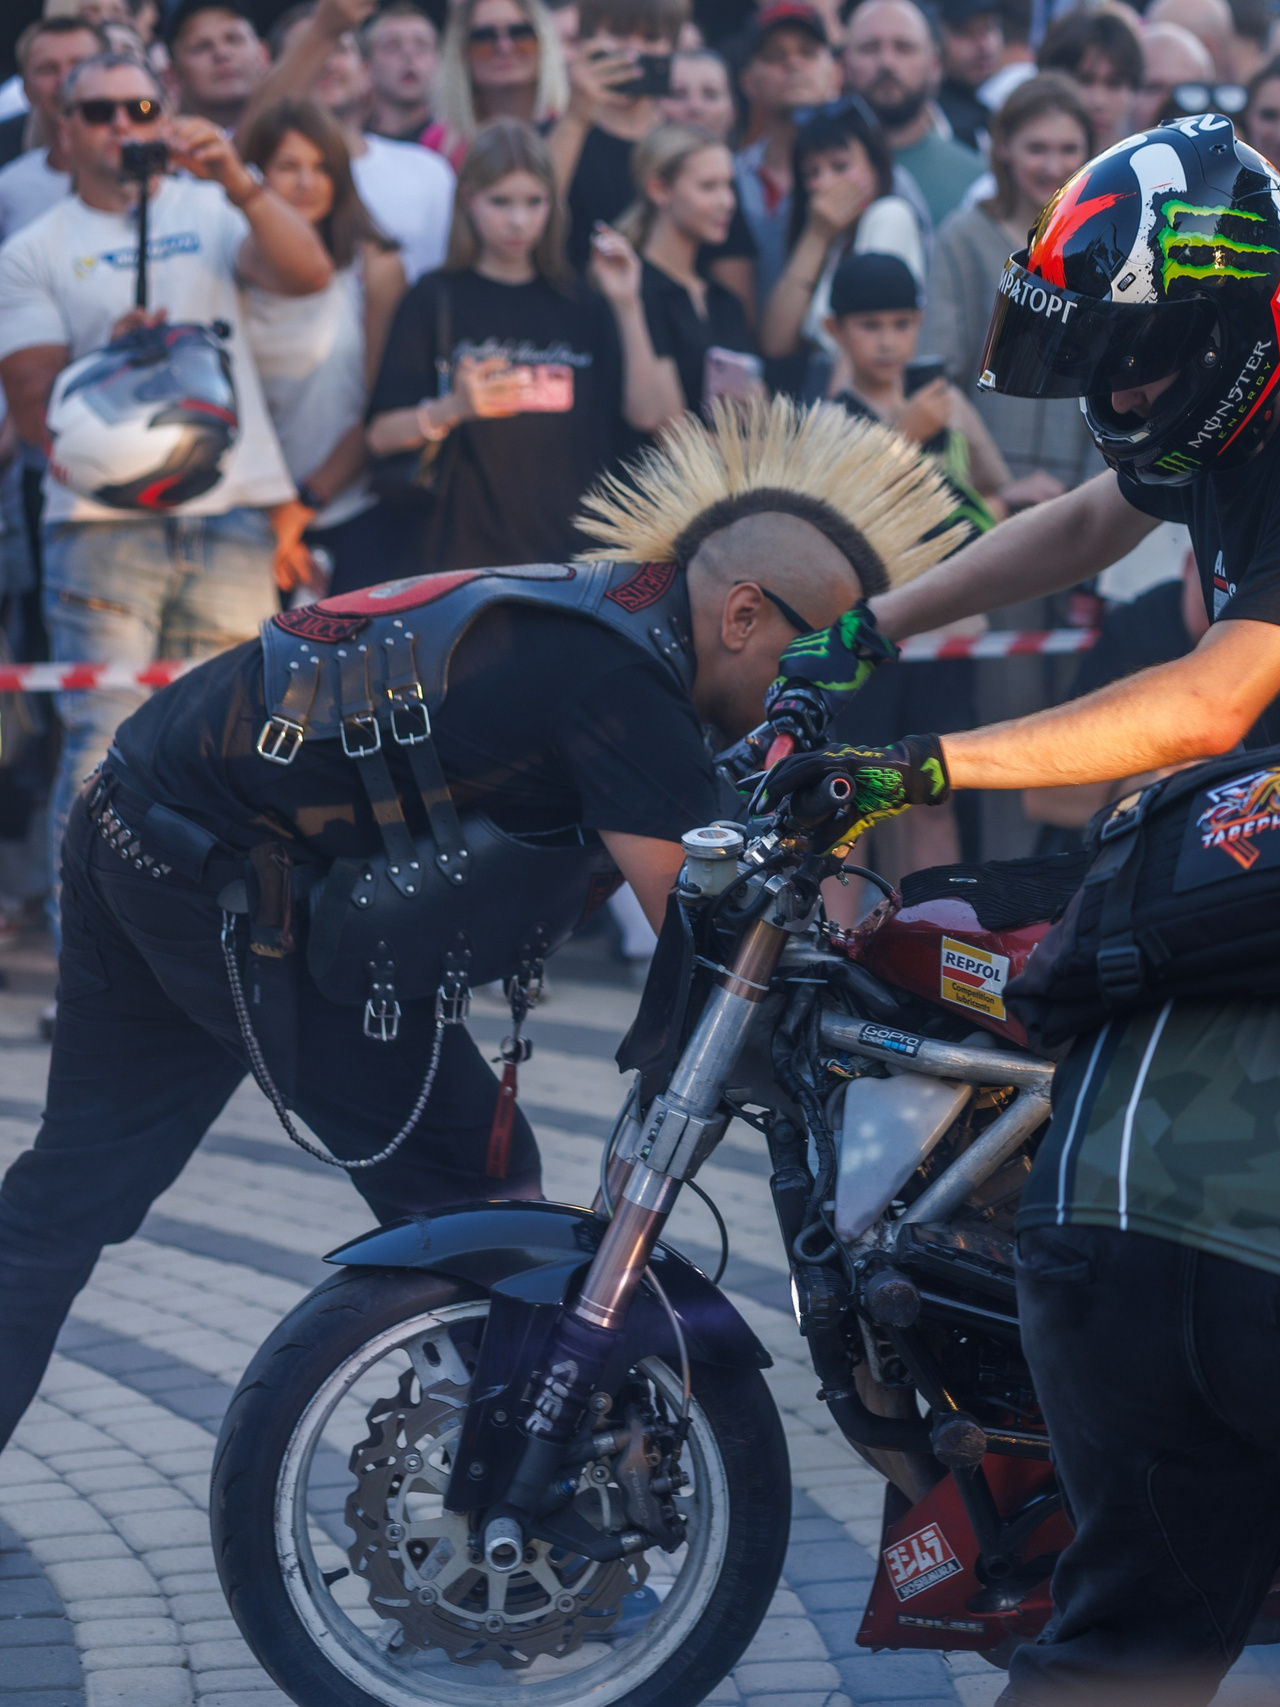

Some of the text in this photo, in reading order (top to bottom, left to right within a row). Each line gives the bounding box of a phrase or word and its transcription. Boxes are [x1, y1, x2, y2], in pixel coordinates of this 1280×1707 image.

[1188, 340, 1272, 448] MONSTER
[1218, 362, 1271, 439] ENERGY
[945, 951, 1002, 982] REPSOL
[951, 982, 995, 1004] Competition
[955, 992, 991, 1012] lubricants
[865, 1025, 919, 1046] GoPro
